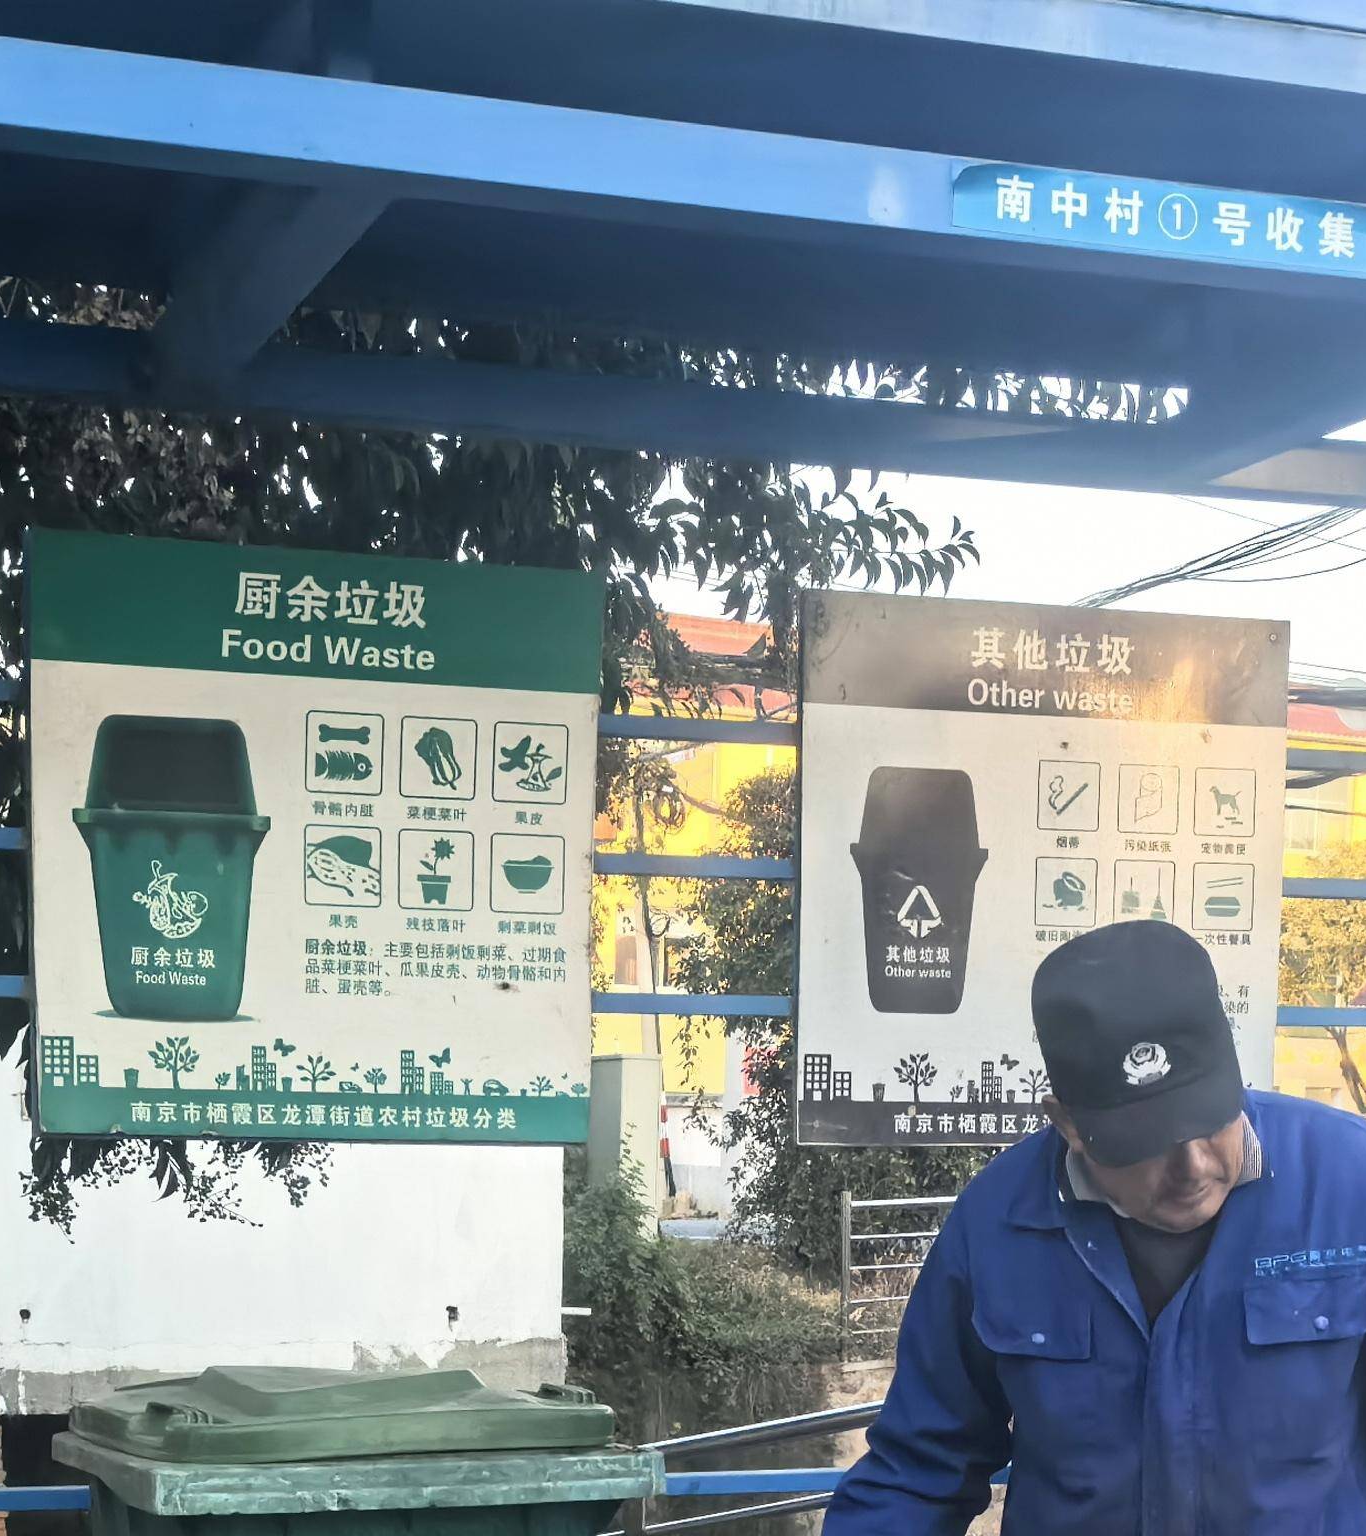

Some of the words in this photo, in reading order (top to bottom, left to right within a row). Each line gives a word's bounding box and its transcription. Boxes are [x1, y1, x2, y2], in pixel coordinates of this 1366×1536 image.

[234, 571, 428, 630] 厨余垃圾
[220, 629, 312, 665] Food
[324, 636, 436, 672] Waste
[970, 626, 1135, 677] 其他垃圾
[967, 678, 1044, 709] Other
[1053, 686, 1134, 714] waste
[312, 800, 374, 818] 骨骼内脏
[407, 805, 467, 822] 菜梗菜叶
[514, 811, 543, 826] 果皮
[1056, 835, 1080, 849] 烟蒂
[1124, 839, 1172, 853] 污染纸张
[1201, 842, 1246, 855] 宠物粪便
[328, 913, 359, 929] 果壳
[405, 917, 466, 933] 残枝落叶
[497, 919, 557, 936] 剩菜剩饭
[1194, 933, 1251, 945] 一次性餐具
[130, 946, 216, 968] 厨余垃圾
[885, 945, 951, 964] 其他垃圾
[136, 970, 166, 985] Food
[169, 970, 207, 986] Waste
[885, 965, 915, 978] Other
[919, 967, 952, 979] waste
[129, 1099, 517, 1130] 南京市栖霞区龙潭街道农村垃圾分类
[894, 1112, 1053, 1134] 南京市栖霞区龙
